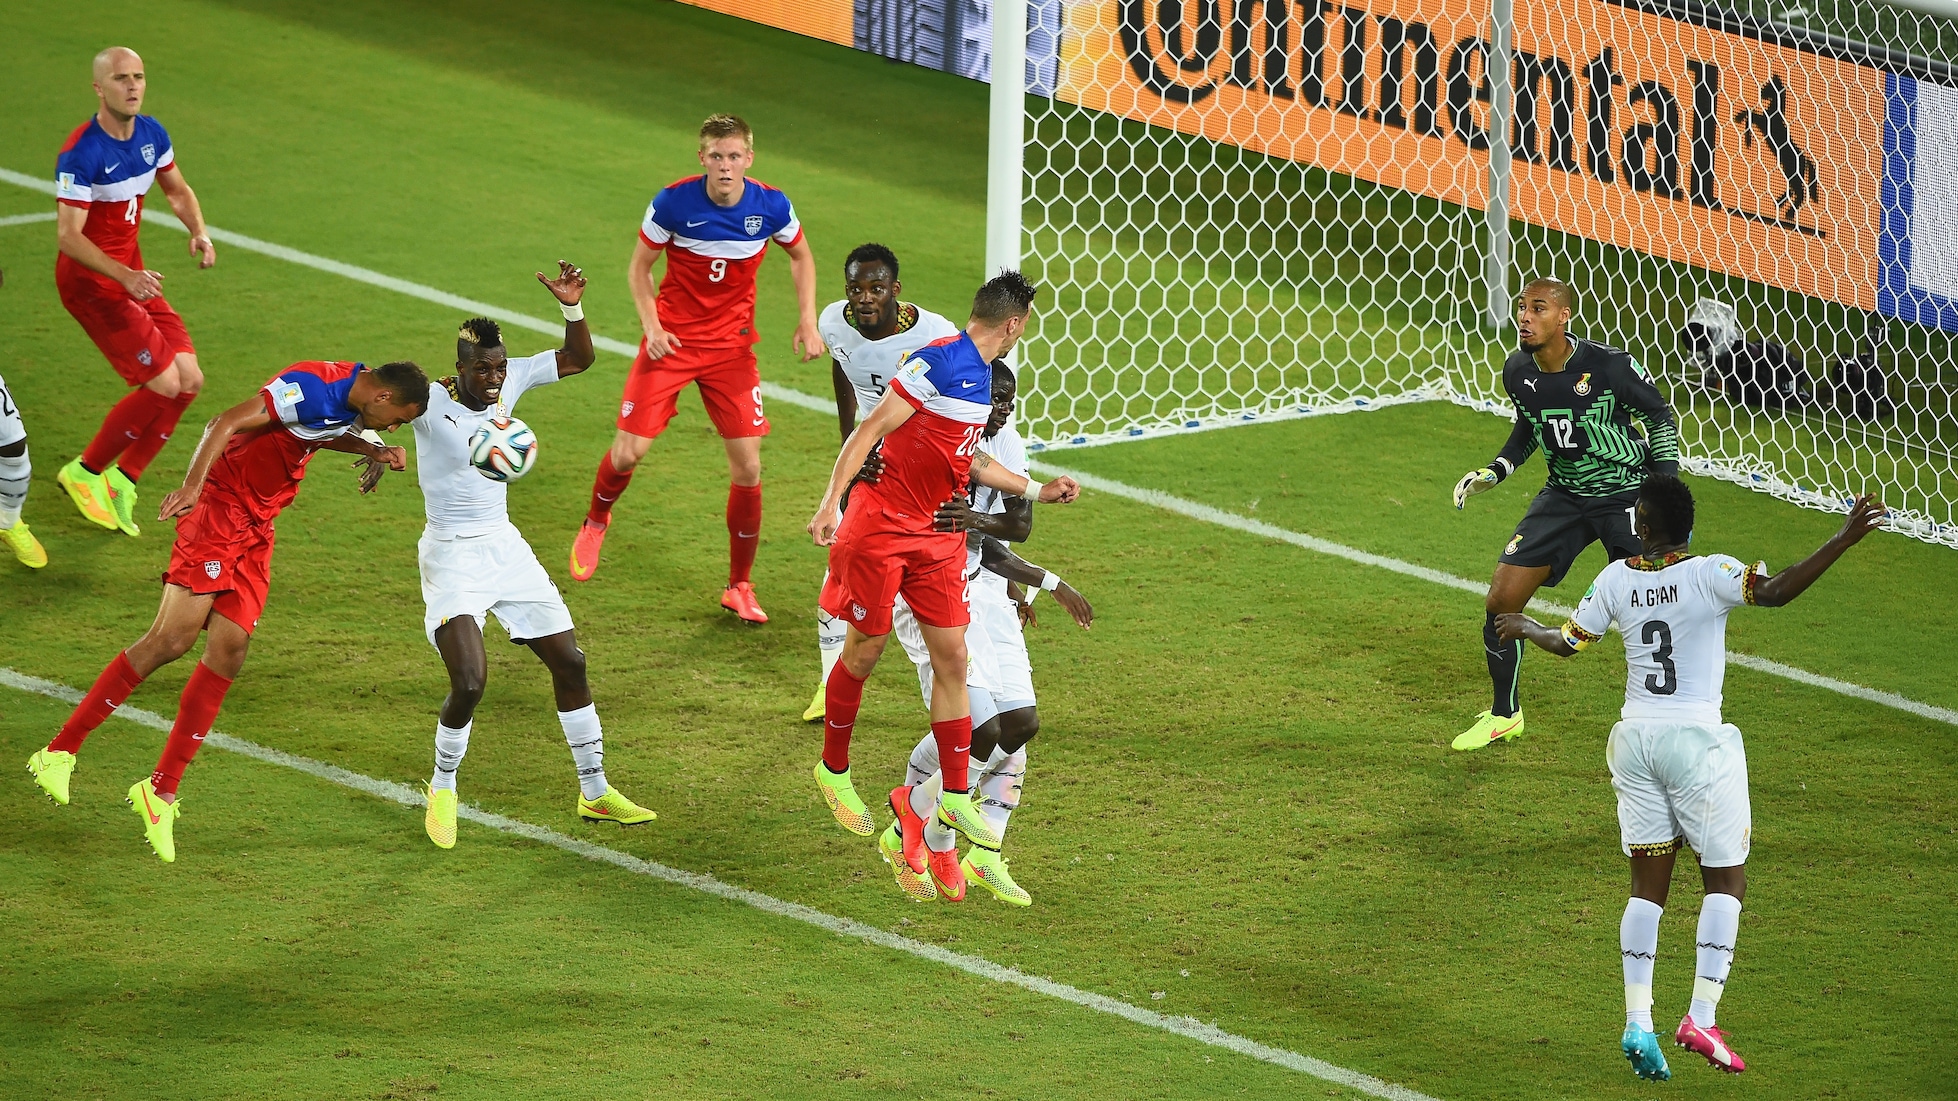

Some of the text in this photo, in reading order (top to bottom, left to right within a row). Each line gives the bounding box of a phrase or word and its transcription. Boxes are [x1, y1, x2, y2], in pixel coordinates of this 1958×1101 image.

[1118, 0, 1722, 211] Continental
[125, 197, 138, 225] 4
[709, 259, 728, 283] 9
[871, 373, 886, 396] 5
[751, 386, 764, 418] 9
[955, 426, 985, 457] 20
[1548, 419, 1578, 449] 12
[1625, 507, 1638, 536] 1
[1631, 590, 1643, 607] A.
[1641, 620, 1677, 695] 3
